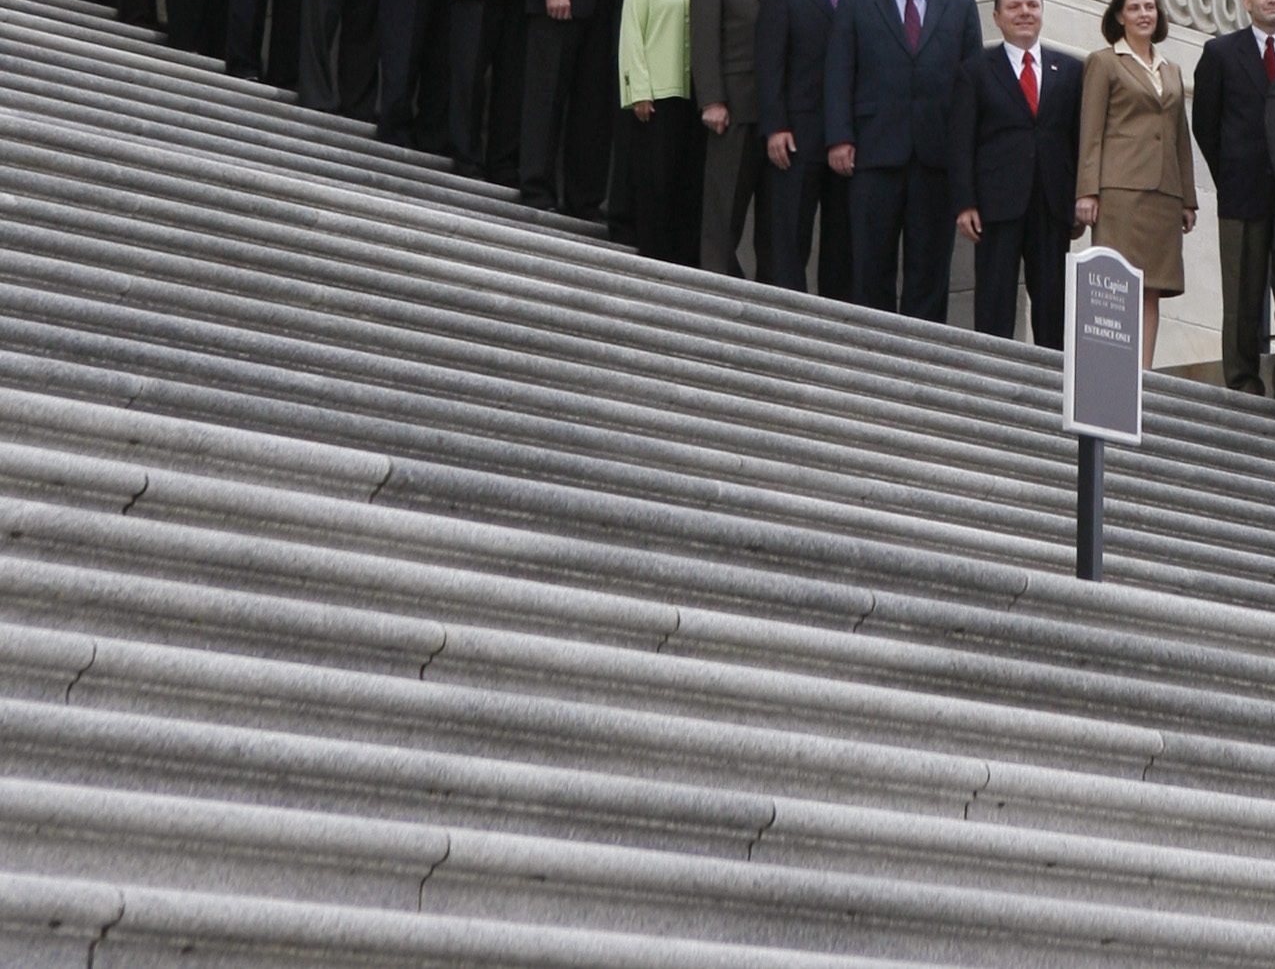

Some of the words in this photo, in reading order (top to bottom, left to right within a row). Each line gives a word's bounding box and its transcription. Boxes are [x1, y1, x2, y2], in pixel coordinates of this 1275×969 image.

[1088, 272, 1103, 288] U.S.
[1104, 277, 1129, 294] Capitol
[1094, 316, 1122, 330] MEMBERS
[1084, 324, 1114, 339] ENTRANCE
[1115, 331, 1131, 343] ONLY
